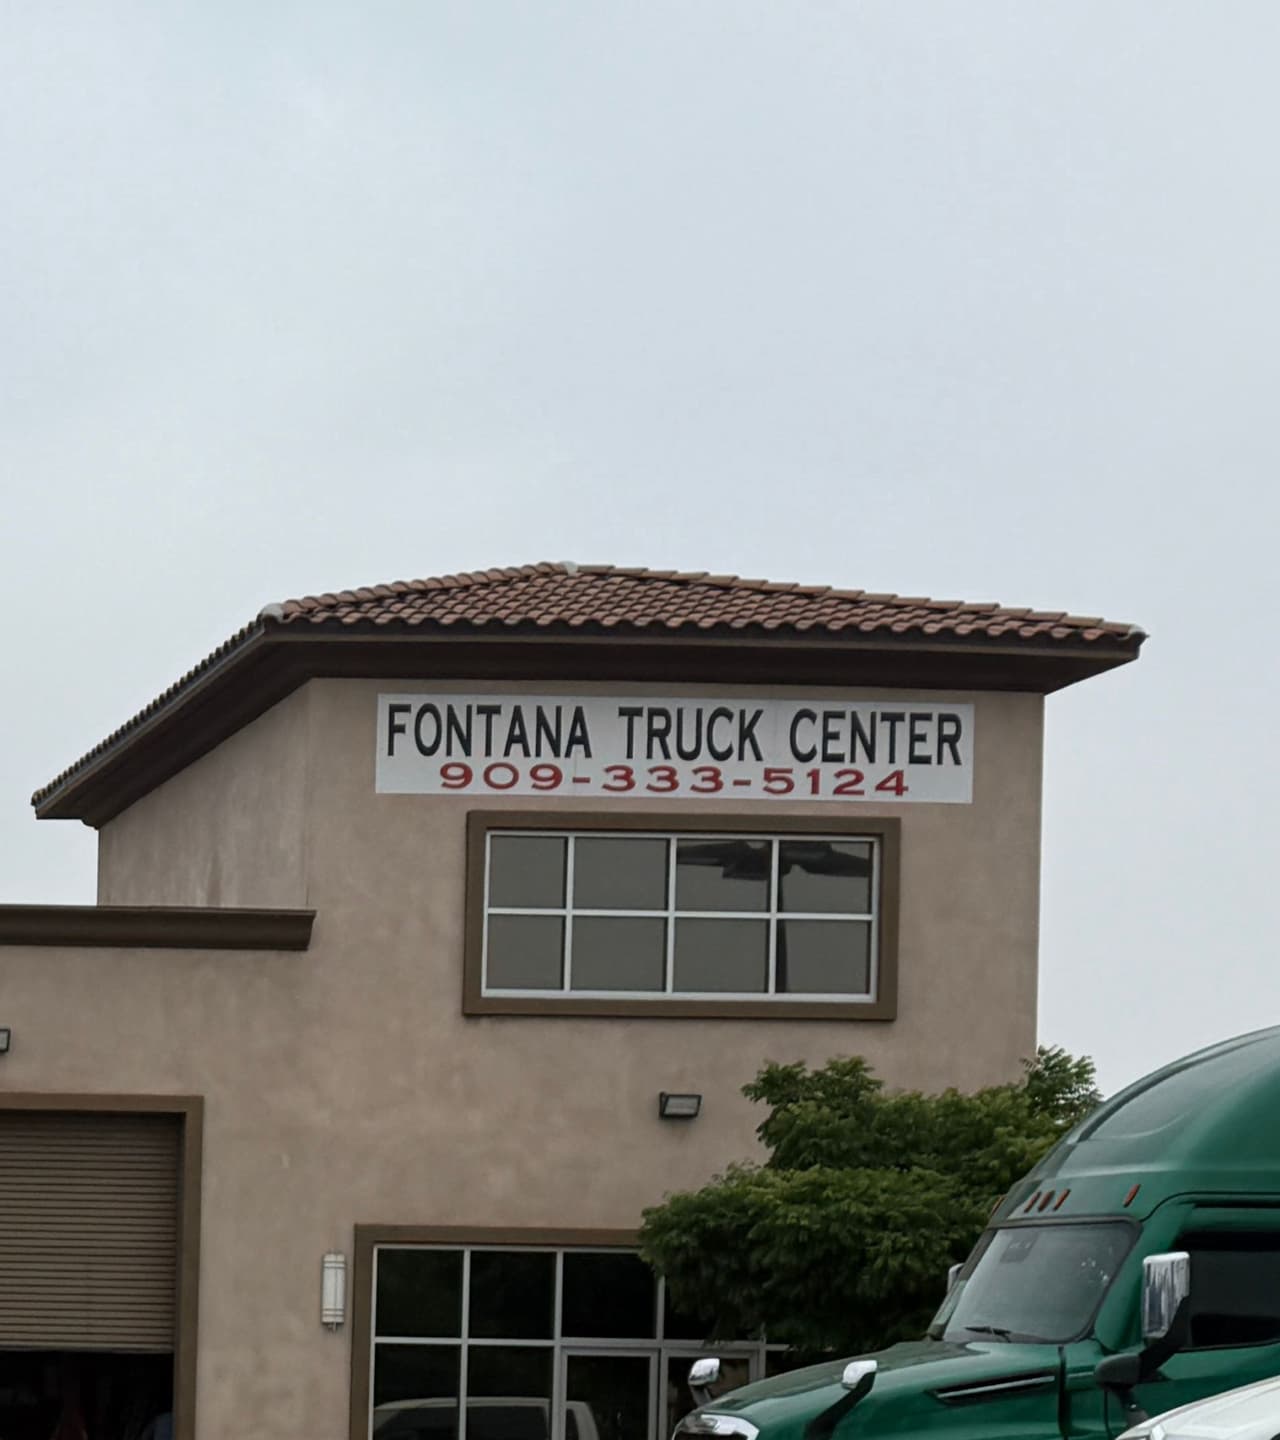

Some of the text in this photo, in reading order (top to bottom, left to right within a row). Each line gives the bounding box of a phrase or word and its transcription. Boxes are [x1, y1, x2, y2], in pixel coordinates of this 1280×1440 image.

[386, 703, 963, 766] FONTANA TRUCK CENTER
[439, 761, 910, 797] 909-333-5124
